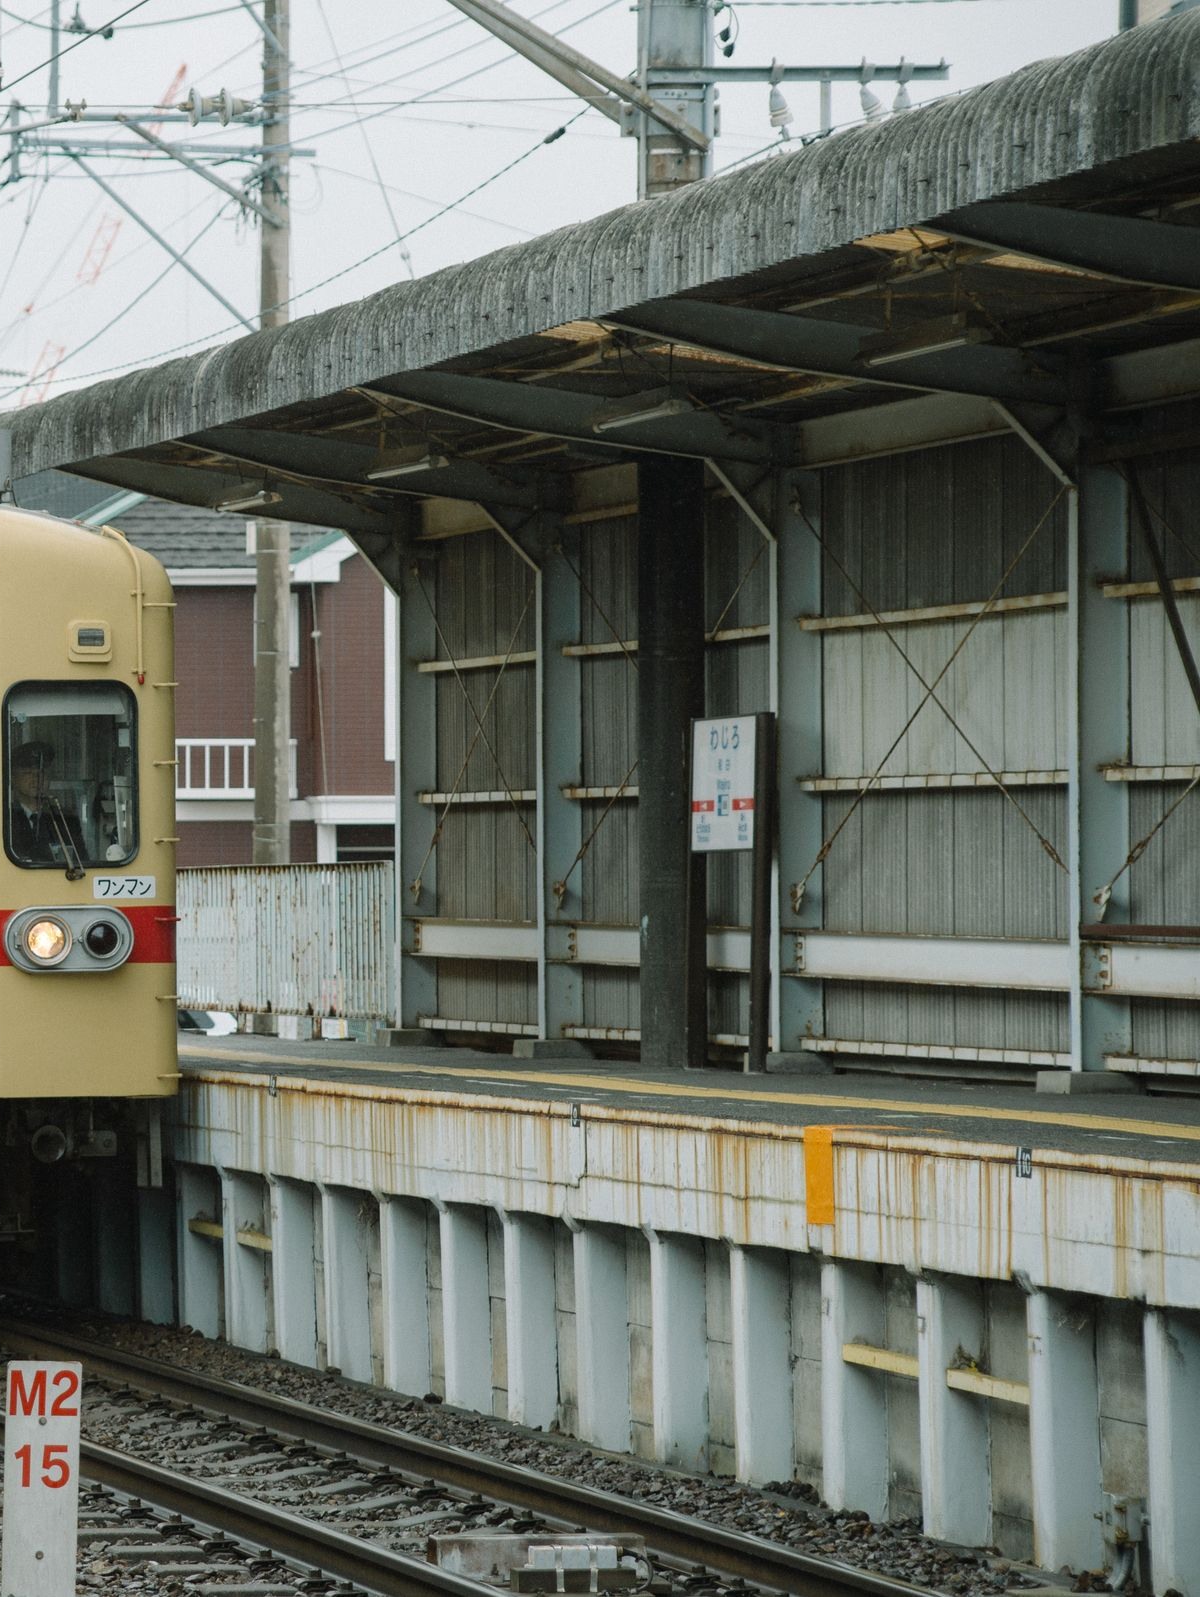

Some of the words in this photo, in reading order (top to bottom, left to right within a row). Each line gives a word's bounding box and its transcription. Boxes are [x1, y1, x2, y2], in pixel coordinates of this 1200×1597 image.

[710, 725, 740, 750] わじろ
[98, 879, 151, 896] ワンマン
[9, 1369, 79, 1417] M2
[14, 1444, 70, 1489] 15
